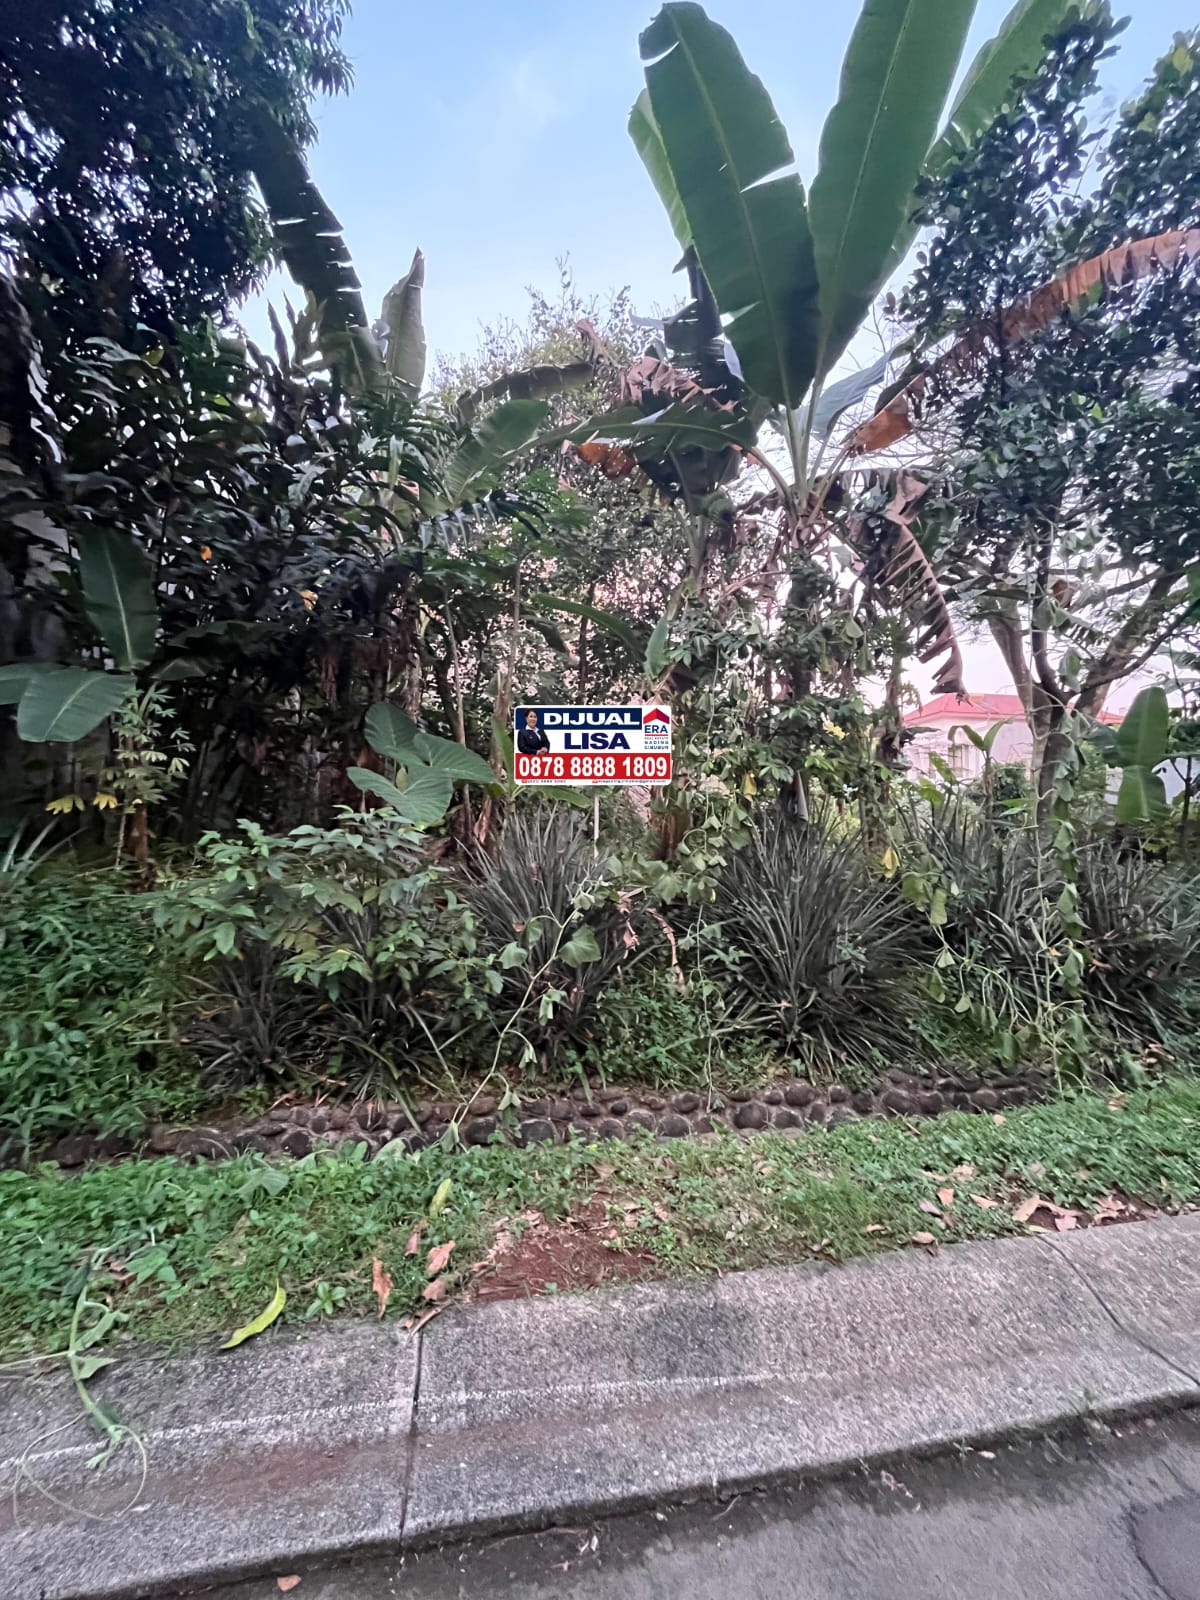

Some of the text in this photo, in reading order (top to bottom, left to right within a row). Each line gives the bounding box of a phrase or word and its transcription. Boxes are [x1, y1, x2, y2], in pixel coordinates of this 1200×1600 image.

[543, 712, 640, 726] DIJUAL
[644, 724, 669, 734] ERA
[564, 732, 631, 750] LISA
[518, 756, 667, 777] 0878 8888 1809
